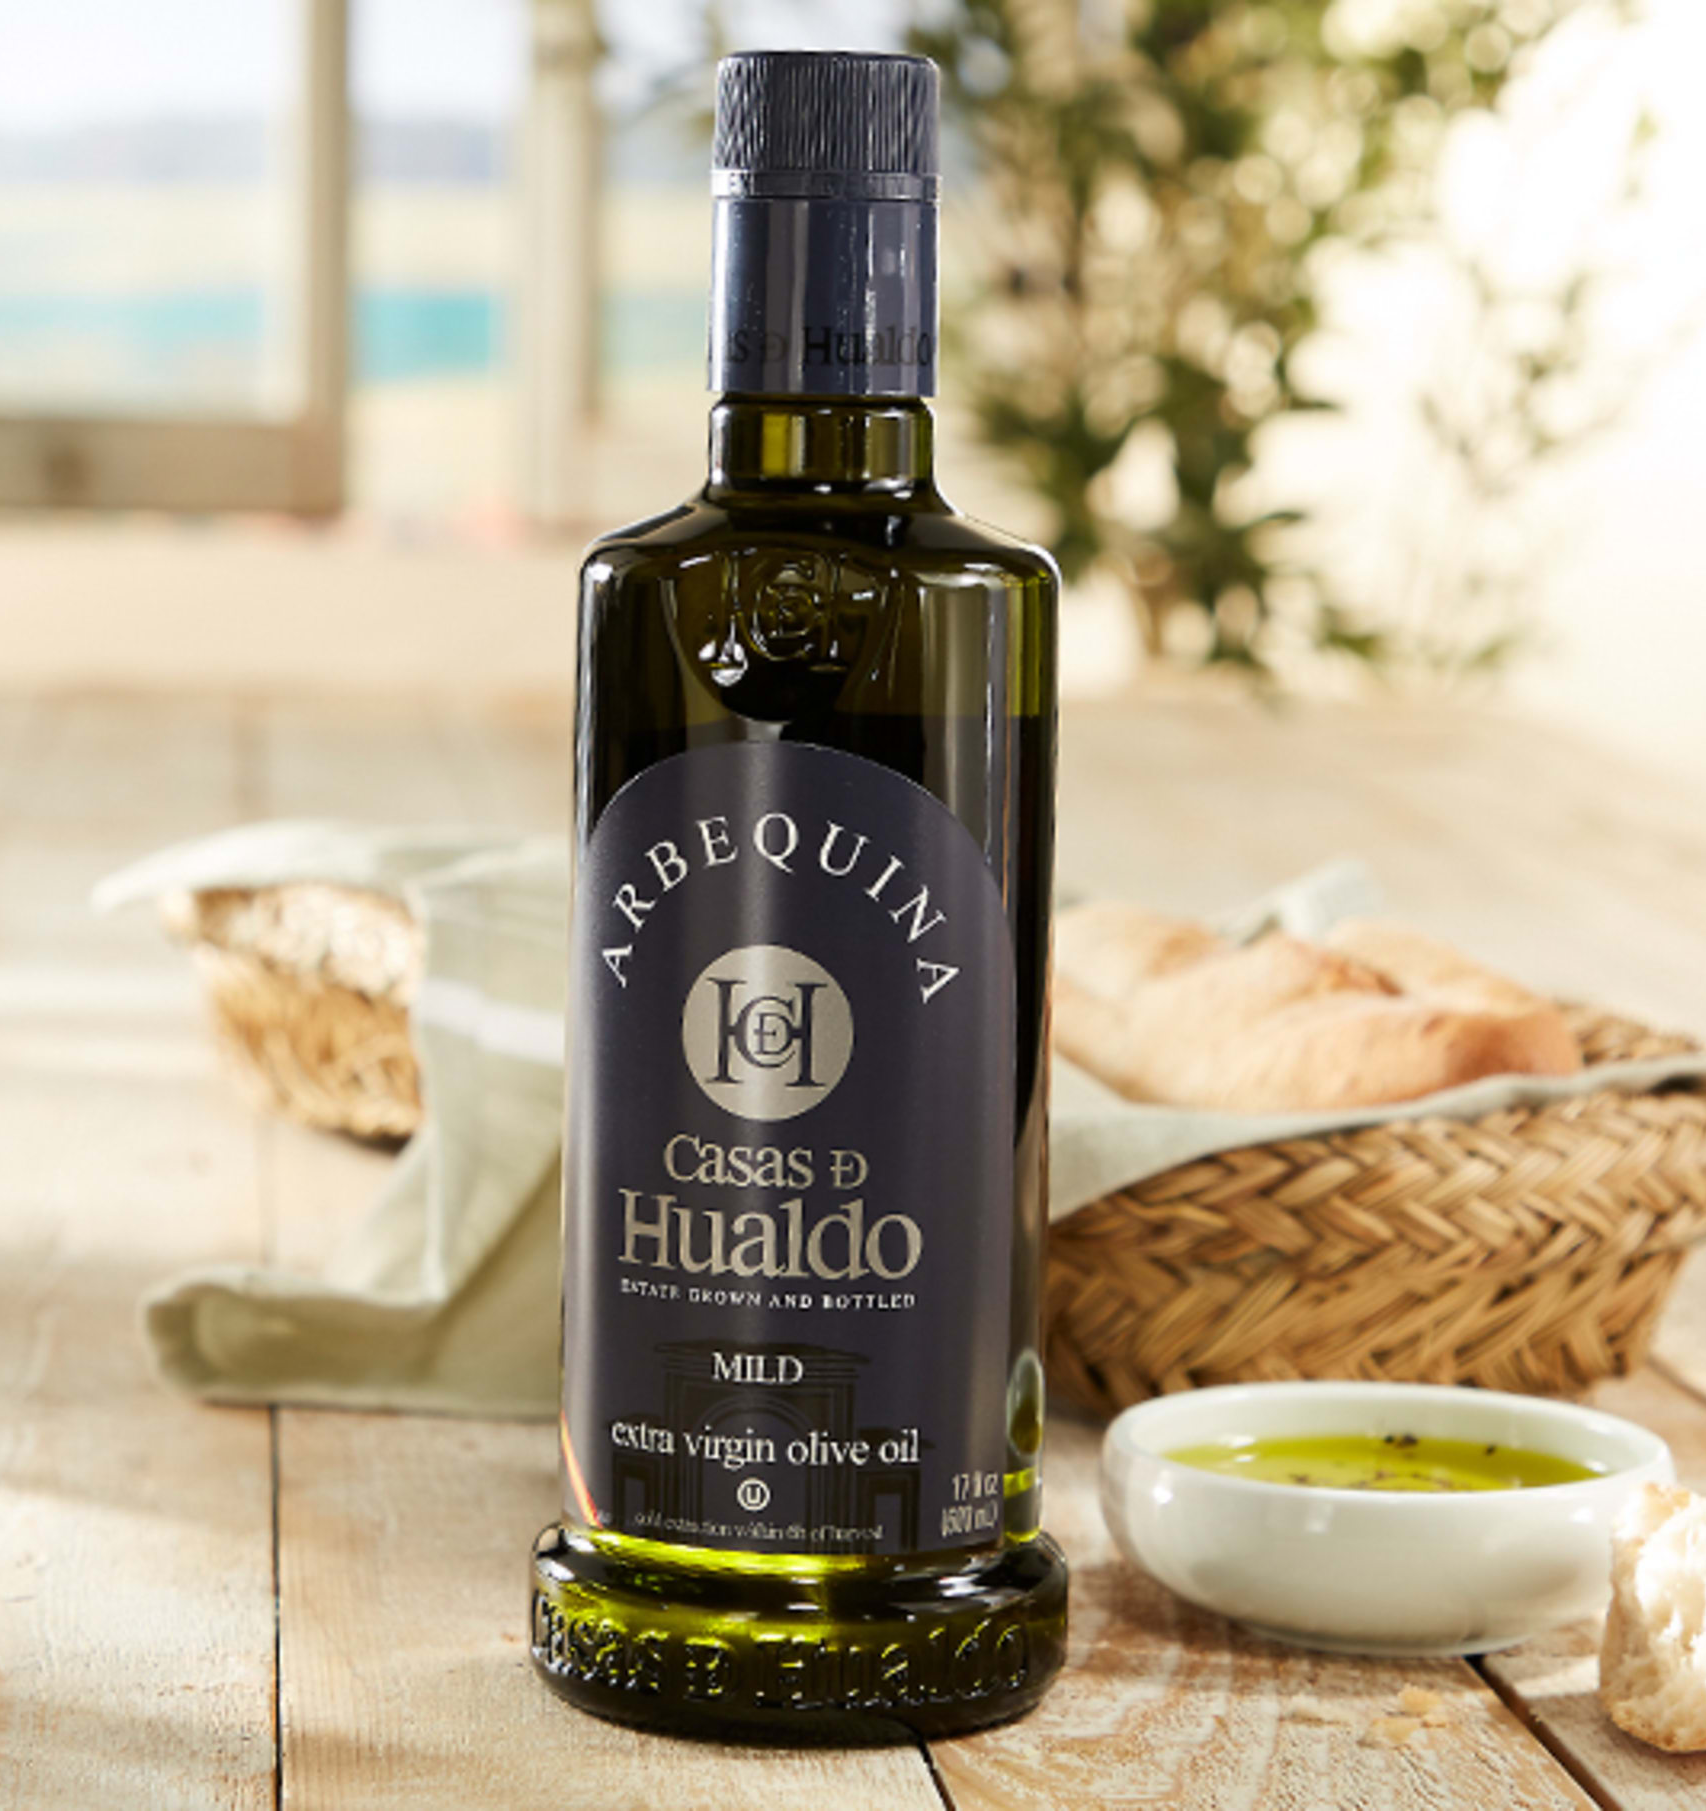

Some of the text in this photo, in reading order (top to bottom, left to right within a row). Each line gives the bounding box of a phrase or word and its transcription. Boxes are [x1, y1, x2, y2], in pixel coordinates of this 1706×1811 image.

[601, 812, 960, 1004] ARBEQUINA
[664, 1134, 815, 1188] Casas
[618, 1188, 923, 1280] Hualdo
[620, 1277, 916, 1310] ESTATE GROWN AND BOTTLED
[712, 1351, 804, 1385] MILD
[611, 1420, 921, 1471] extra virgin olive oil
[952, 1472, 969, 1501] 17
